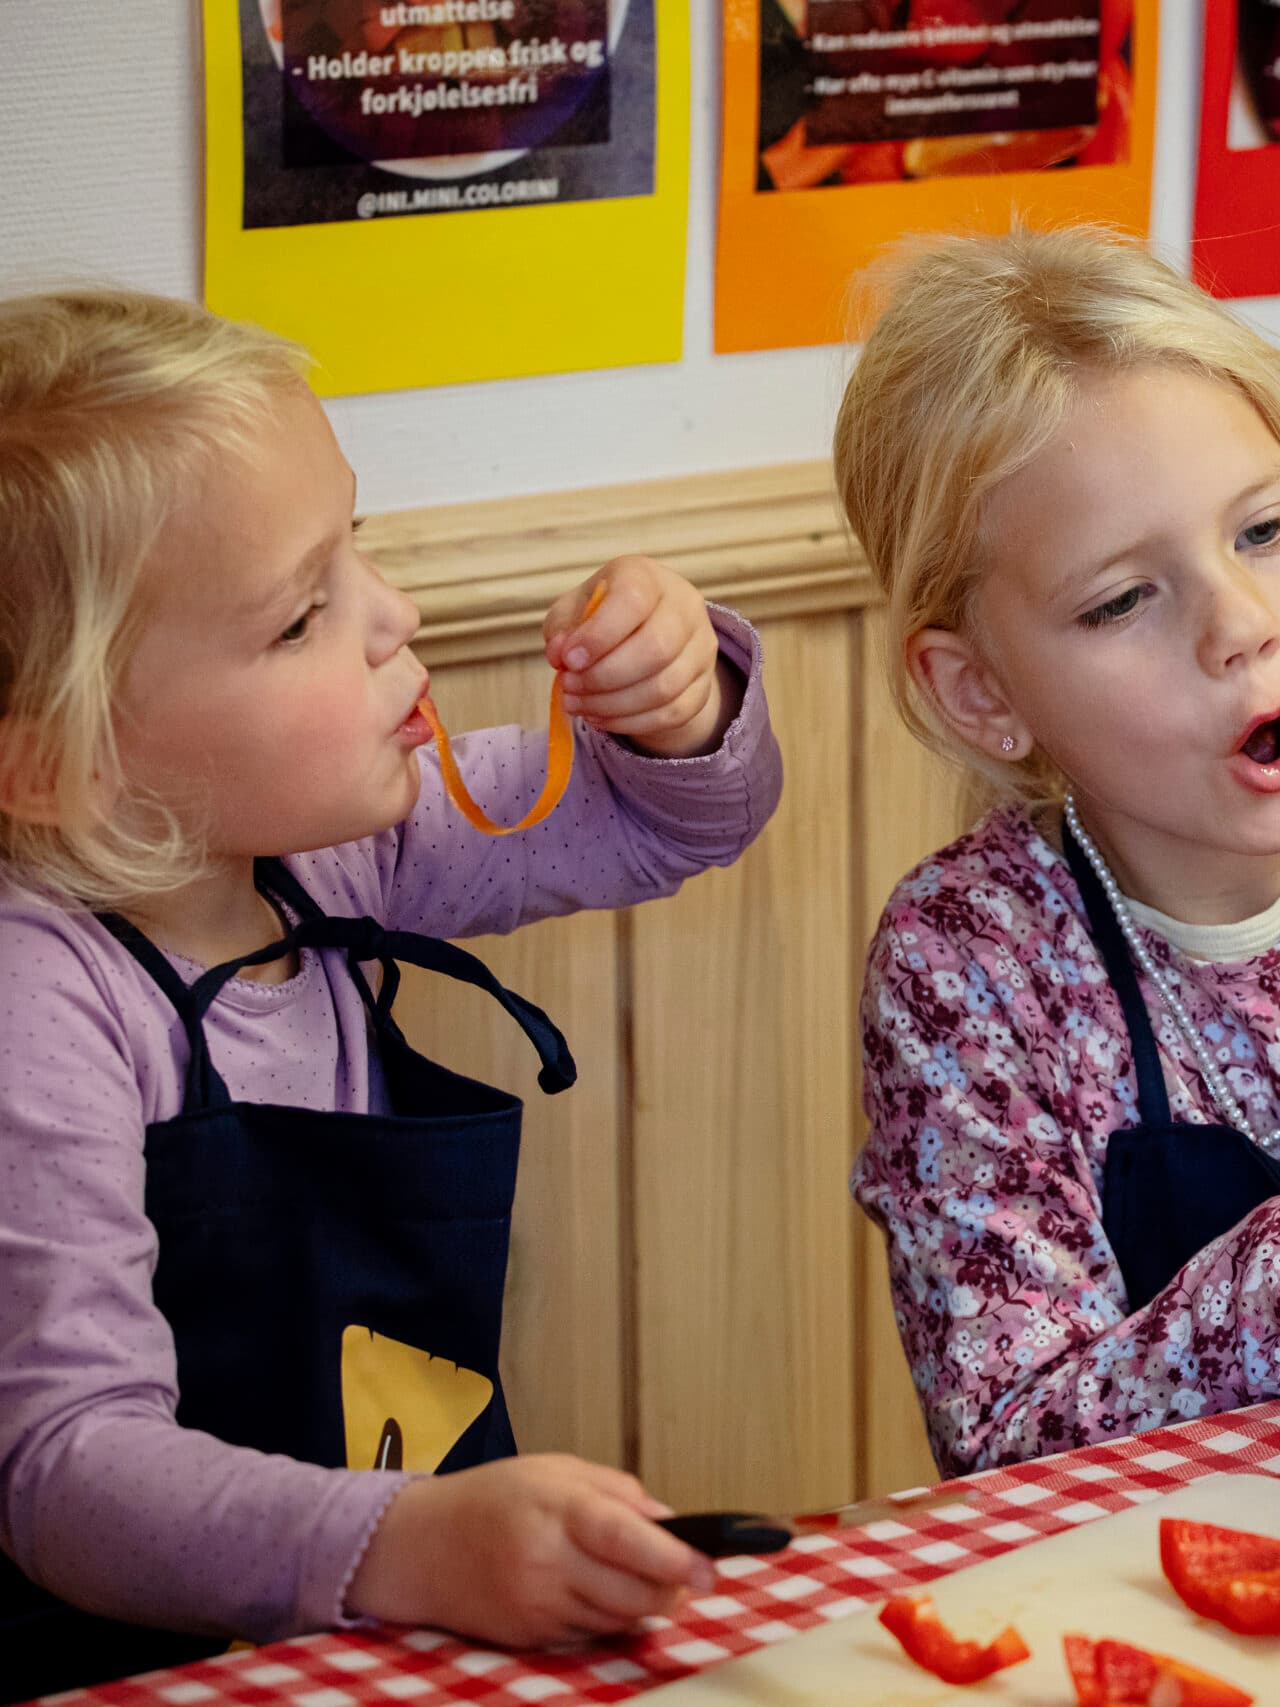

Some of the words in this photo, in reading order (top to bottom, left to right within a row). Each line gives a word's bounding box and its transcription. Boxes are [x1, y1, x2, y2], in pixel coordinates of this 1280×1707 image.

[381, 0, 515, 27] utmattelse
[307, 51, 394, 81] Holder
[398, 46, 507, 76] kroppen
[508, 38, 567, 67] frisk
[570, 39, 605, 68] og
[361, 76, 538, 117] forkjølelsesfri
[357, 177, 559, 218] @INI.MINI.COLORINI
